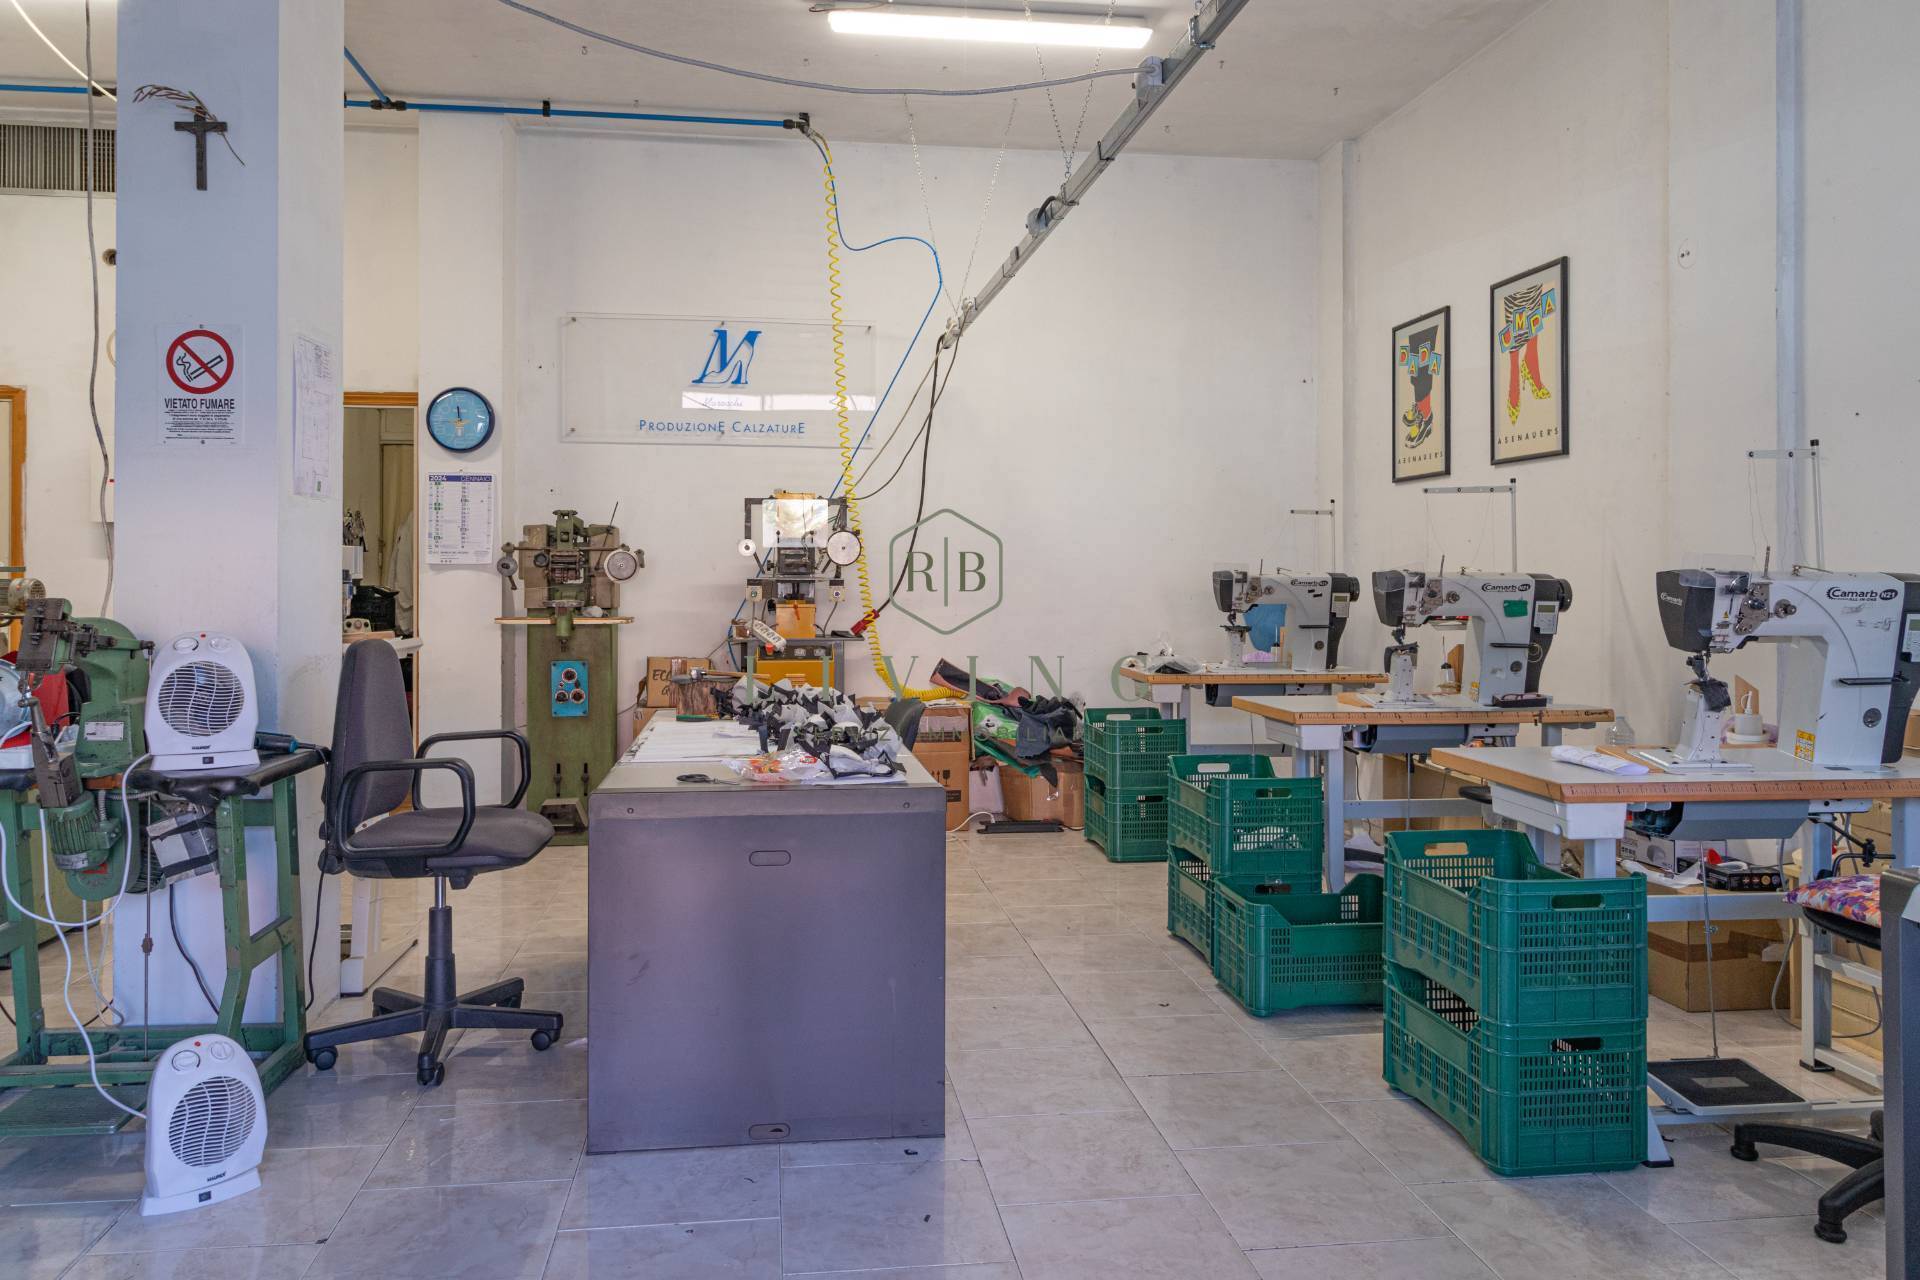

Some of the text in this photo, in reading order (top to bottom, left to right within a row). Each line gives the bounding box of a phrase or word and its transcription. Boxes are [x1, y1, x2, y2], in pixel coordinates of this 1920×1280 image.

[1400, 345, 1440, 375] DADA
[164, 398, 235, 410] VIETATO FUMARE
[639, 419, 806, 434] PRODUZIONE CALZATURE
[1483, 583, 1517, 592] Camarb
[1829, 588, 1897, 600] Camarb N21
